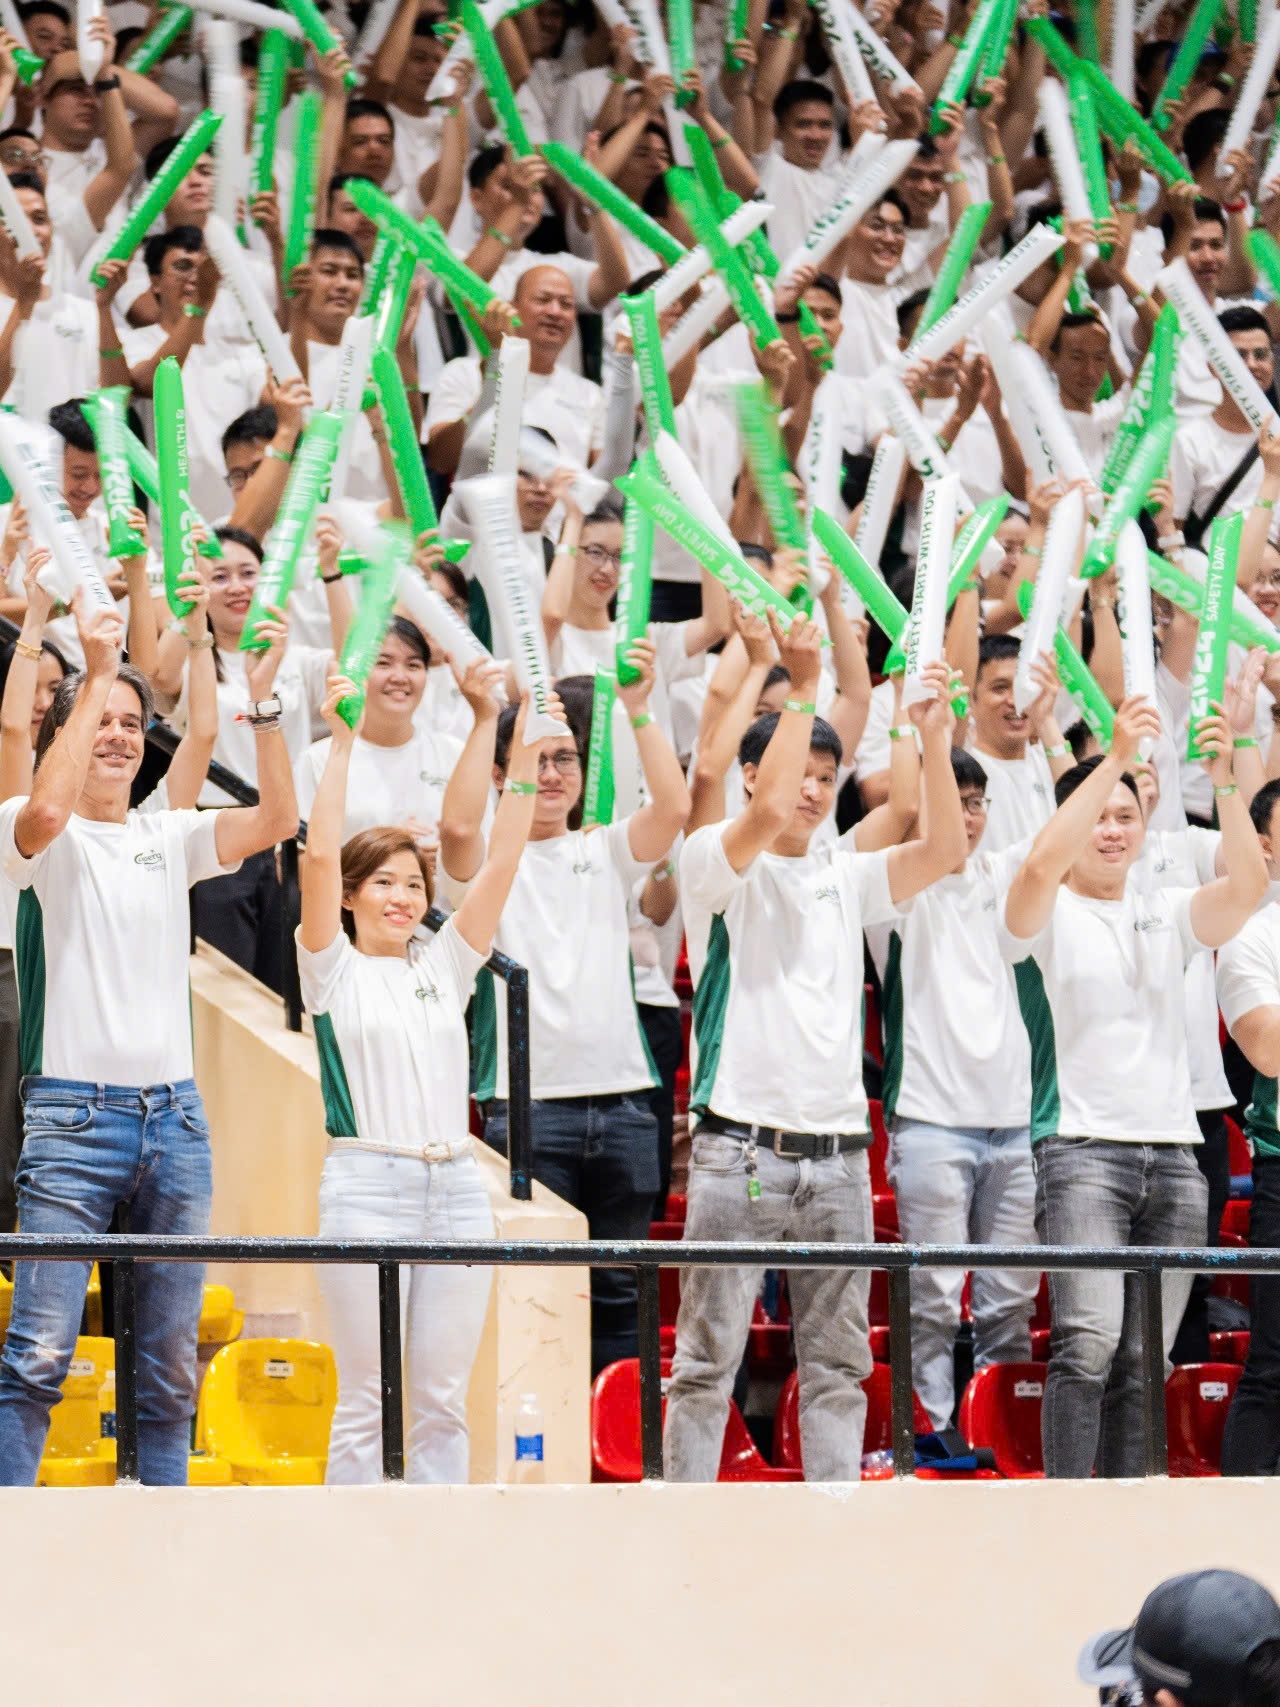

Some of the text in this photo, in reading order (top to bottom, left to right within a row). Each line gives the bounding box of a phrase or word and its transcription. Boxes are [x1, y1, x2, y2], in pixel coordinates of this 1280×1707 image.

[344, 343, 357, 368] DAY
[631, 313, 661, 434] TARTS WITH YOU
[1239, 395, 1276, 441] SFETY
[177, 425, 188, 477] HEALTH
[652, 503, 678, 525] DAY
[922, 488, 936, 520] YOU
[675, 521, 719, 562] SAFETY
[918, 522, 931, 560] WITH
[1212, 543, 1227, 571] DAY
[912, 562, 928, 616] STARTS
[1205, 573, 1223, 622] SAFETY
[907, 619, 922, 675] SAFETY
[523, 631, 540, 676] WITH
[532, 679, 547, 715] YOU
[585, 691, 609, 812] SAFETY STARTS
